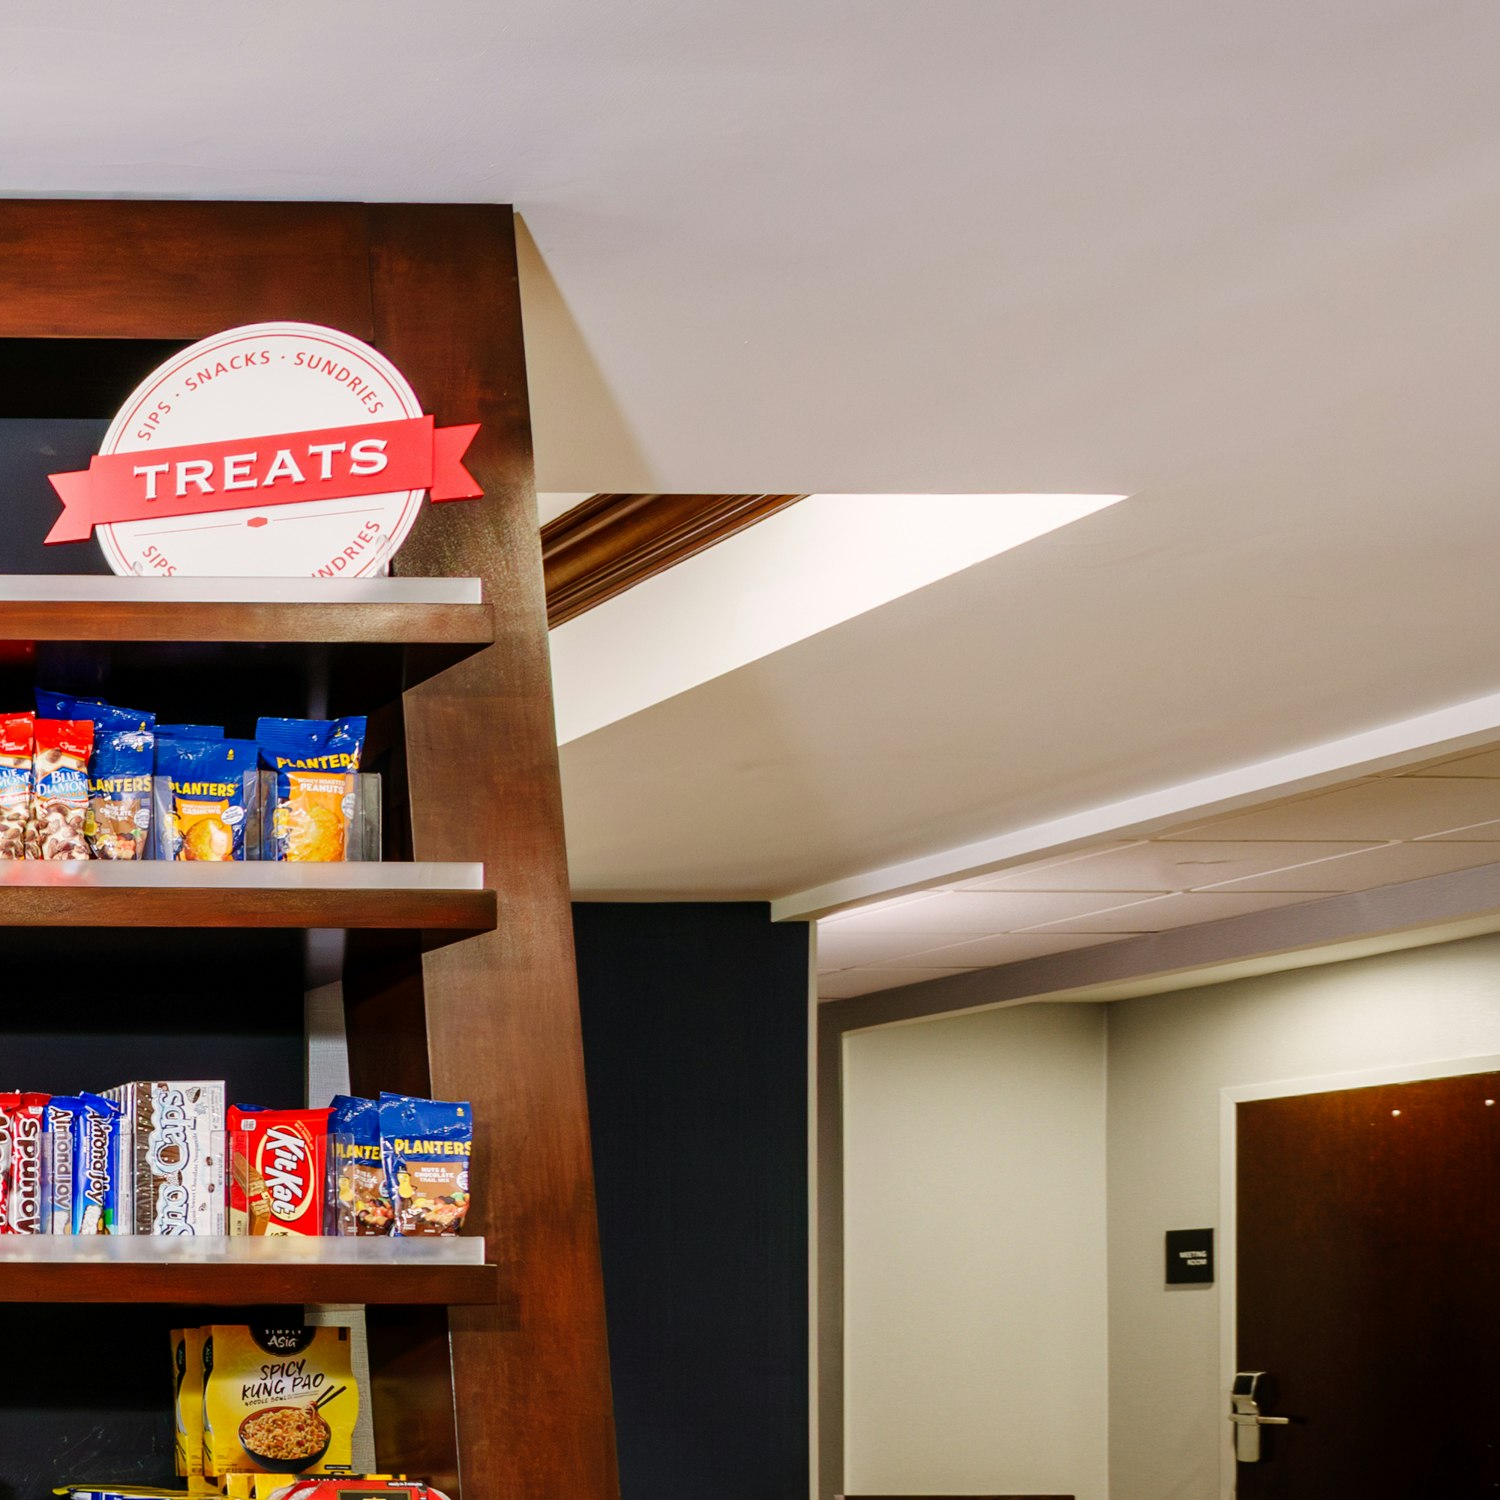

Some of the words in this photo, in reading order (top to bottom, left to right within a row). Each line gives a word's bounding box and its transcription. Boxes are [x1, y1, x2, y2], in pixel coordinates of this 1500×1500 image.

[137, 401, 171, 441] SIPS
[184, 350, 271, 391] SNACKS
[294, 351, 384, 415] SUNDRIES
[133, 439, 389, 501] TREATS
[277, 752, 360, 770] PLANTERS
[51, 771, 81, 784] BLUE
[169, 781, 236, 797] PLANTERS
[300, 783, 344, 795] PEANUTS
[395, 1138, 472, 1155] PLANTERS
[260, 1359, 306, 1381] SPICY
[241, 1379, 286, 1402] KUNG
[291, 1373, 325, 1392] PAO
